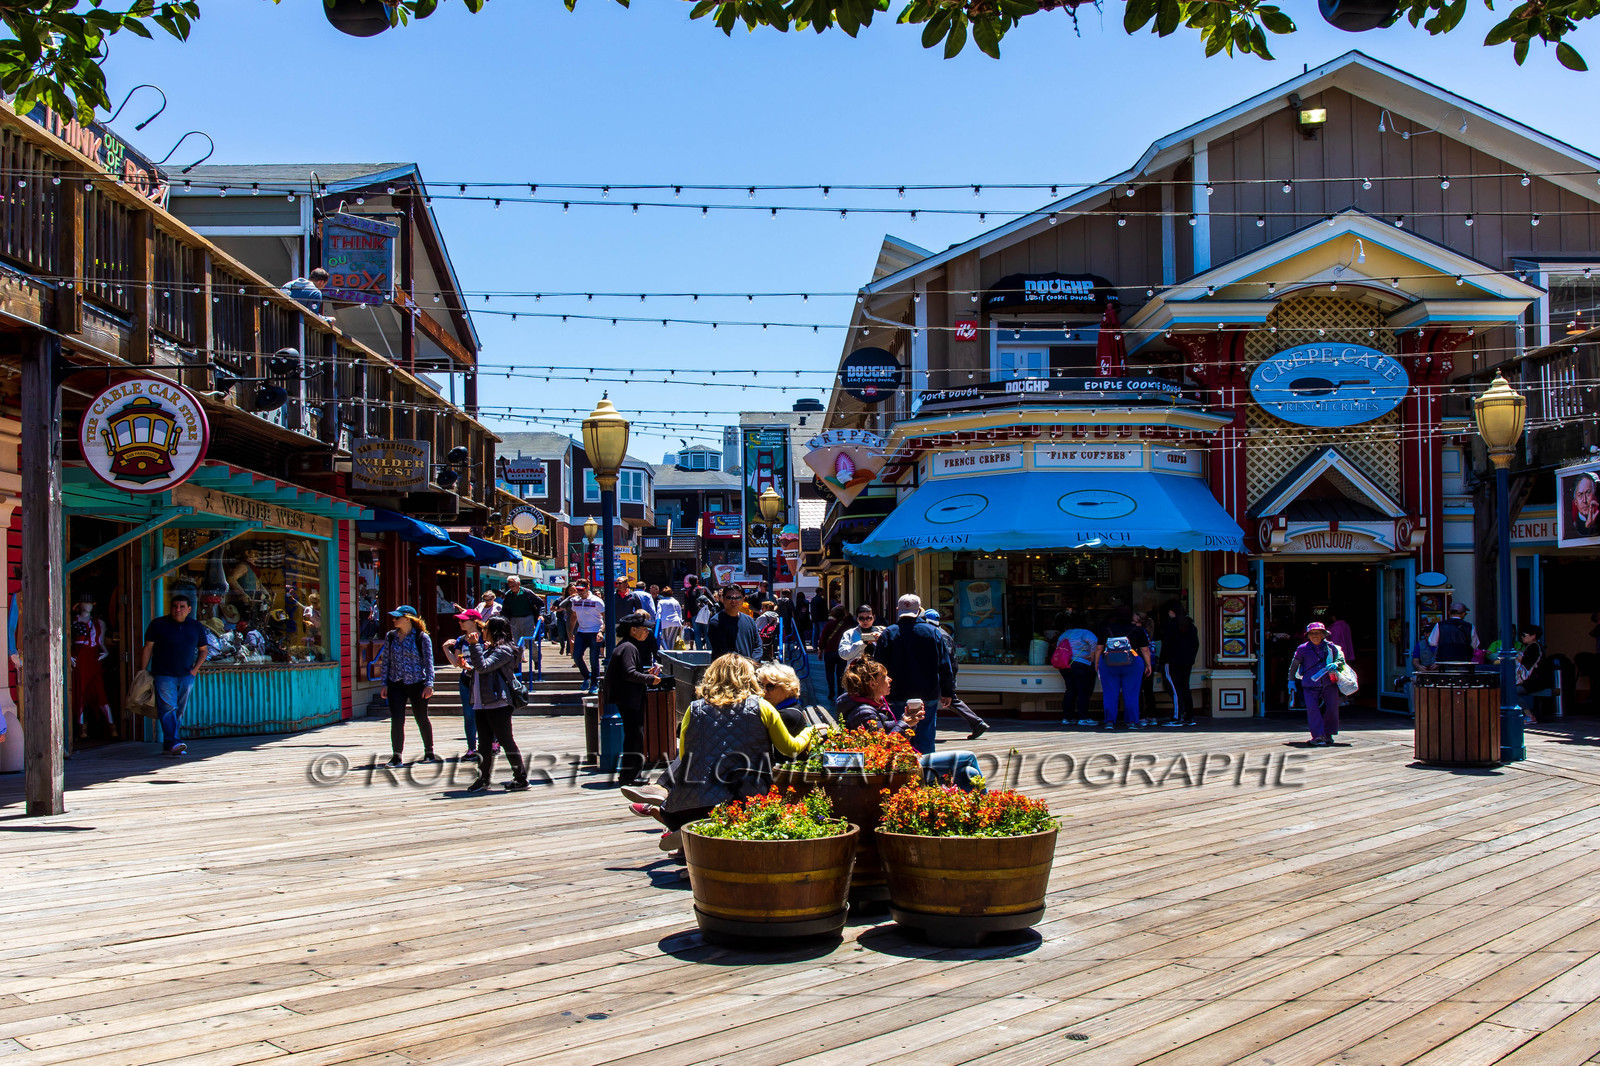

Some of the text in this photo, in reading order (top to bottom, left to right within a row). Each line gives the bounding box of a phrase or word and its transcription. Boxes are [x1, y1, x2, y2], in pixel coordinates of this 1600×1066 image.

[104, 133, 125, 159] OUT
[341, 216, 390, 235] GAMES
[330, 235, 386, 250] THINK
[332, 270, 386, 294] BOX
[1025, 279, 1094, 294] DOUGHP
[847, 365, 897, 378] DOUGHP
[1260, 347, 1402, 384] CREPE CAFE
[1005, 380, 1050, 394] DOUGHP
[1084, 380, 1182, 394] EDIBLE COOKIE DOUGH
[86, 382, 198, 443] THE CABLE CAR STORE
[1332, 402, 1380, 412] CREPES
[810, 430, 886, 449] CREPES
[944, 453, 1011, 468] FRENCH CREPES
[1050, 450, 1076, 460] FINE
[356, 458, 425, 468] WILDER
[366, 467, 414, 476] WEST
[221, 494, 305, 529] WILDER WEST
[1077, 532, 1131, 541] LUNCH
[1511, 523, 1548, 539] RENCH
[903, 534, 971, 547] BREAKFAST
[1204, 535, 1239, 546] DINNER
[1303, 532, 1353, 550] BONJOUR
